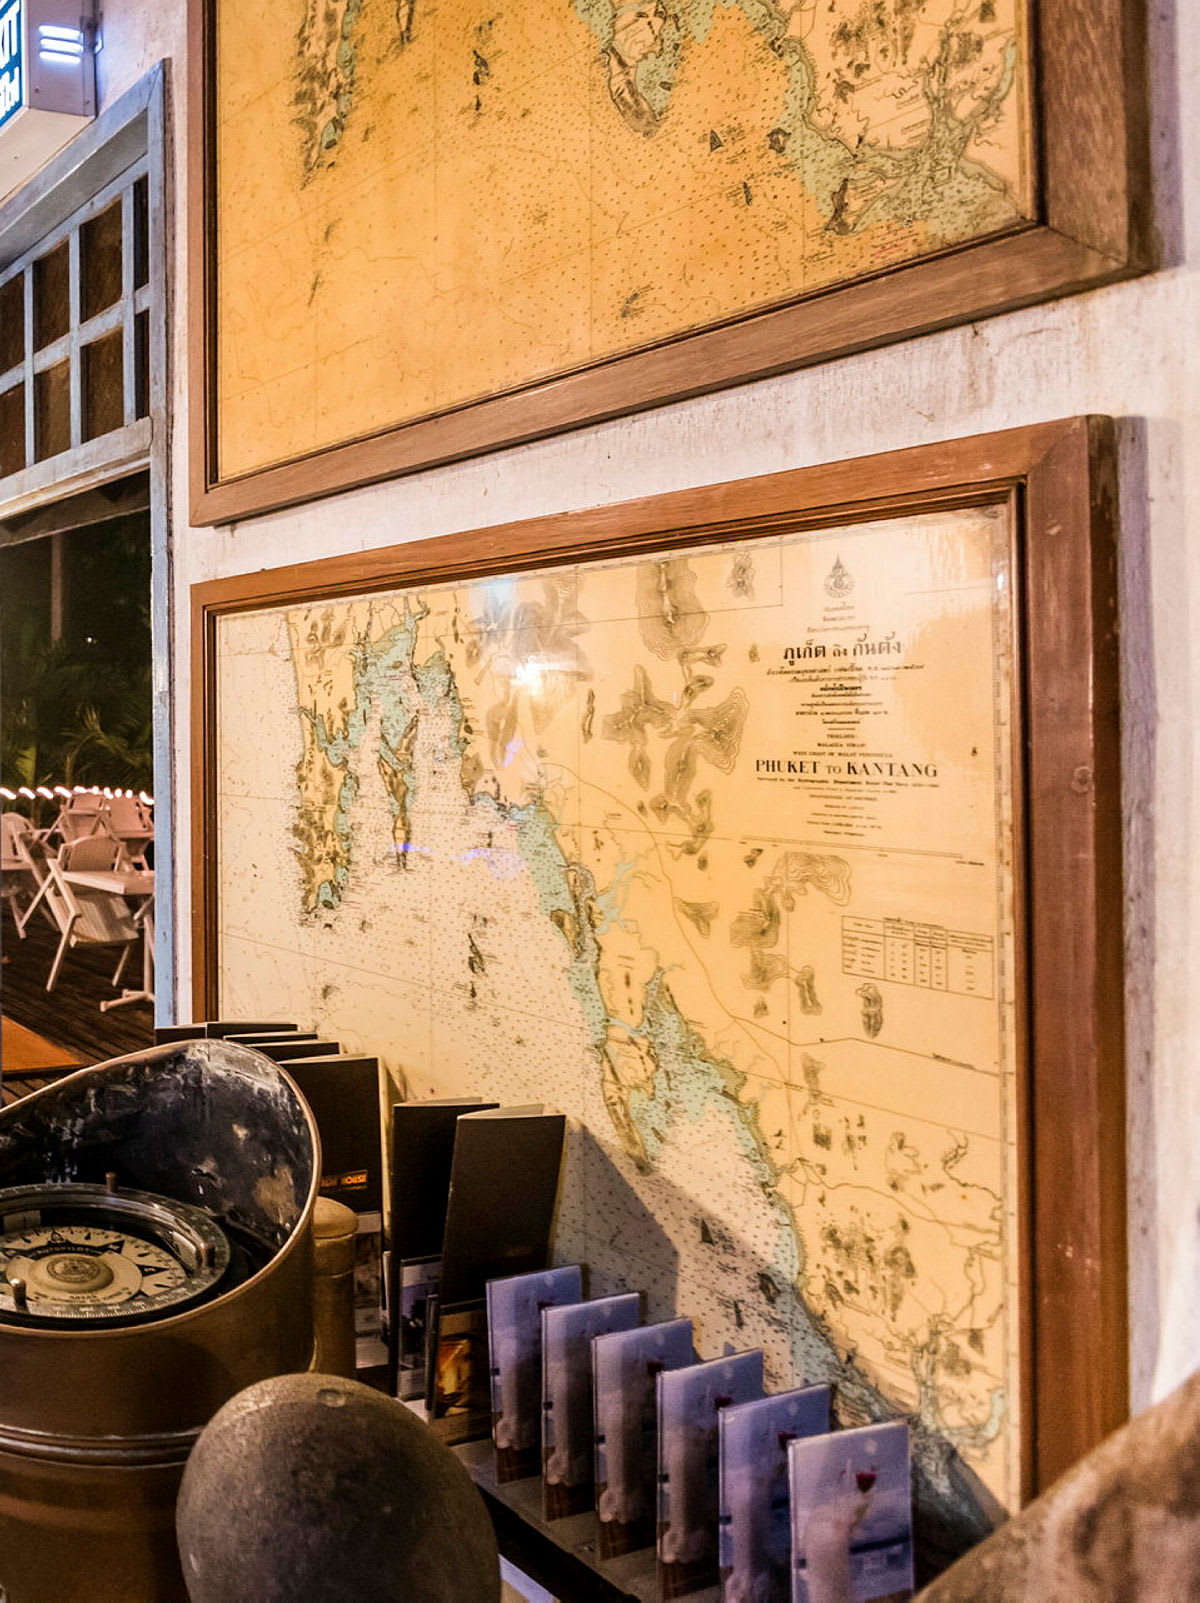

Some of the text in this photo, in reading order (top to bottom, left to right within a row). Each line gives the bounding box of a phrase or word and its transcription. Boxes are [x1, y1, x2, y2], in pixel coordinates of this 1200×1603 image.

[755, 759, 938, 778] PHUKET TO KANTANG
